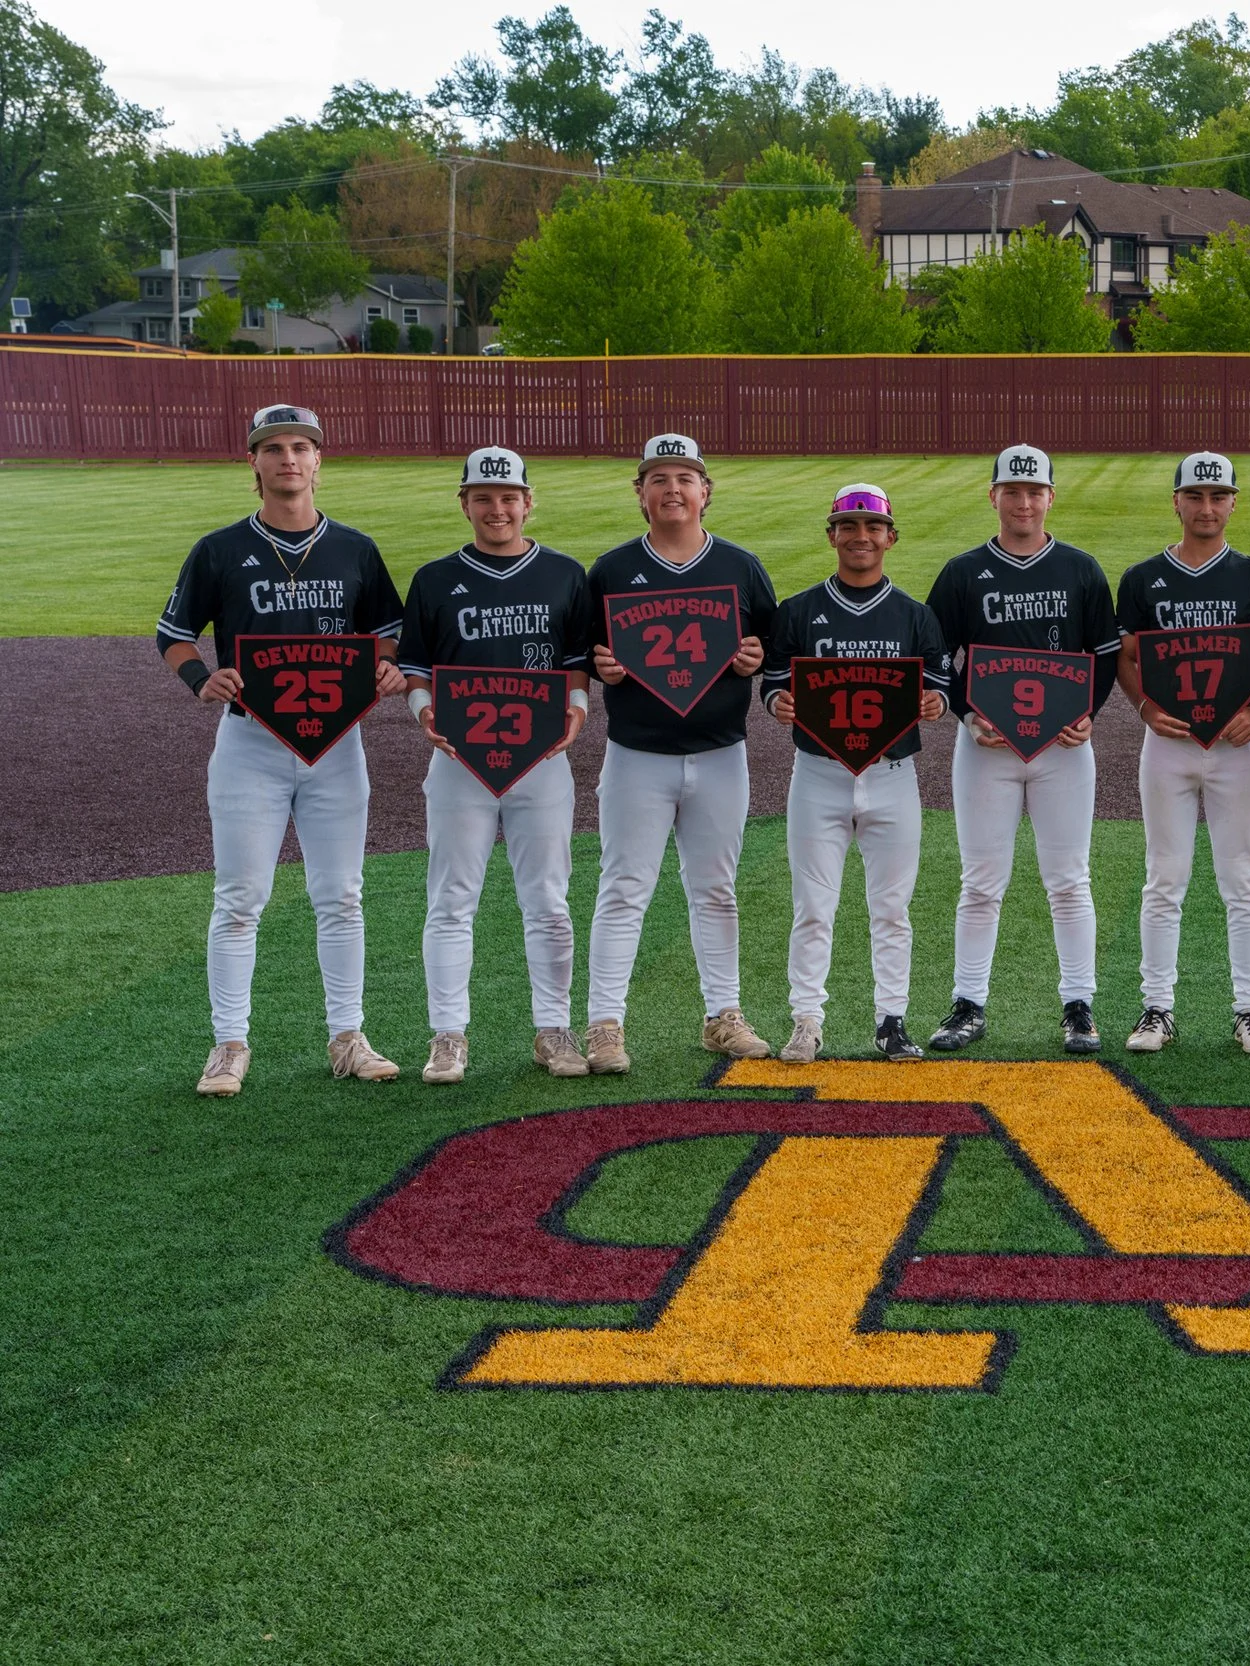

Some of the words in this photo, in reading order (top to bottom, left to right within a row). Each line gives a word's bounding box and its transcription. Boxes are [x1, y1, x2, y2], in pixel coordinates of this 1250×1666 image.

[250, 580, 343, 614] CATHOLIC
[481, 604, 549, 617] MONTINI
[982, 591, 1067, 624] CATHOLIC
[1004, 591, 1067, 603] MONTINI
[1174, 601, 1237, 612] MONTINI
[458, 606, 549, 640] CATHOLIC
[612, 598, 731, 630] THOMPSON
[1155, 600, 1236, 630] CATHOLIC
[252, 644, 360, 669] GEWONT
[523, 642, 554, 670] 23
[642, 622, 707, 667] 24
[836, 641, 900, 650] MONTINI
[1154, 635, 1241, 661] PALMER
[806, 666, 907, 690] RAMIREZ
[975, 657, 1088, 685] PAPROCKAS
[1175, 659, 1224, 701] 17
[273, 670, 343, 713] 25
[449, 677, 550, 703] MANDRA
[1012, 679, 1045, 717] 9
[465, 702, 533, 745] 23
[829, 690, 884, 729] 16
